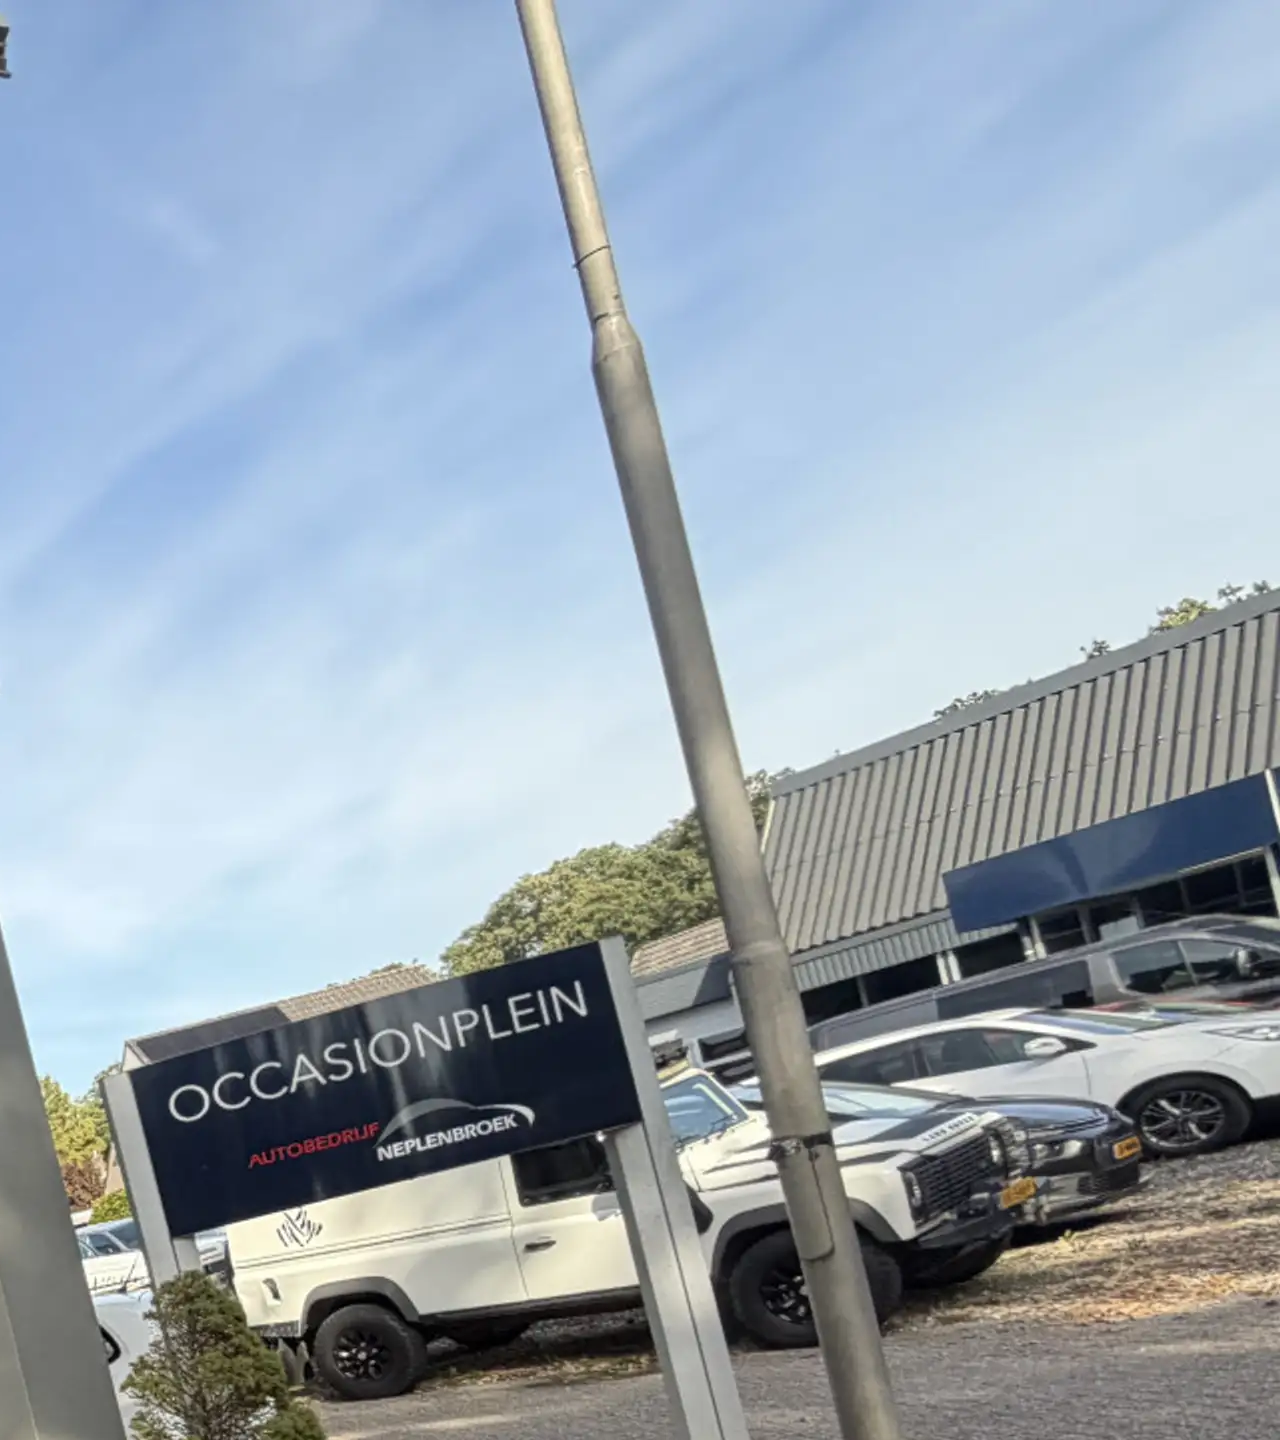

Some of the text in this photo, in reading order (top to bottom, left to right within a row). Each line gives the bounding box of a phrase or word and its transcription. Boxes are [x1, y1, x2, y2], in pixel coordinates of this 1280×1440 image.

[168, 980, 589, 1123] OCCASIONPLEIN
[248, 1113, 518, 1169] AUTOBEDRIJF NEPLENBROEK
